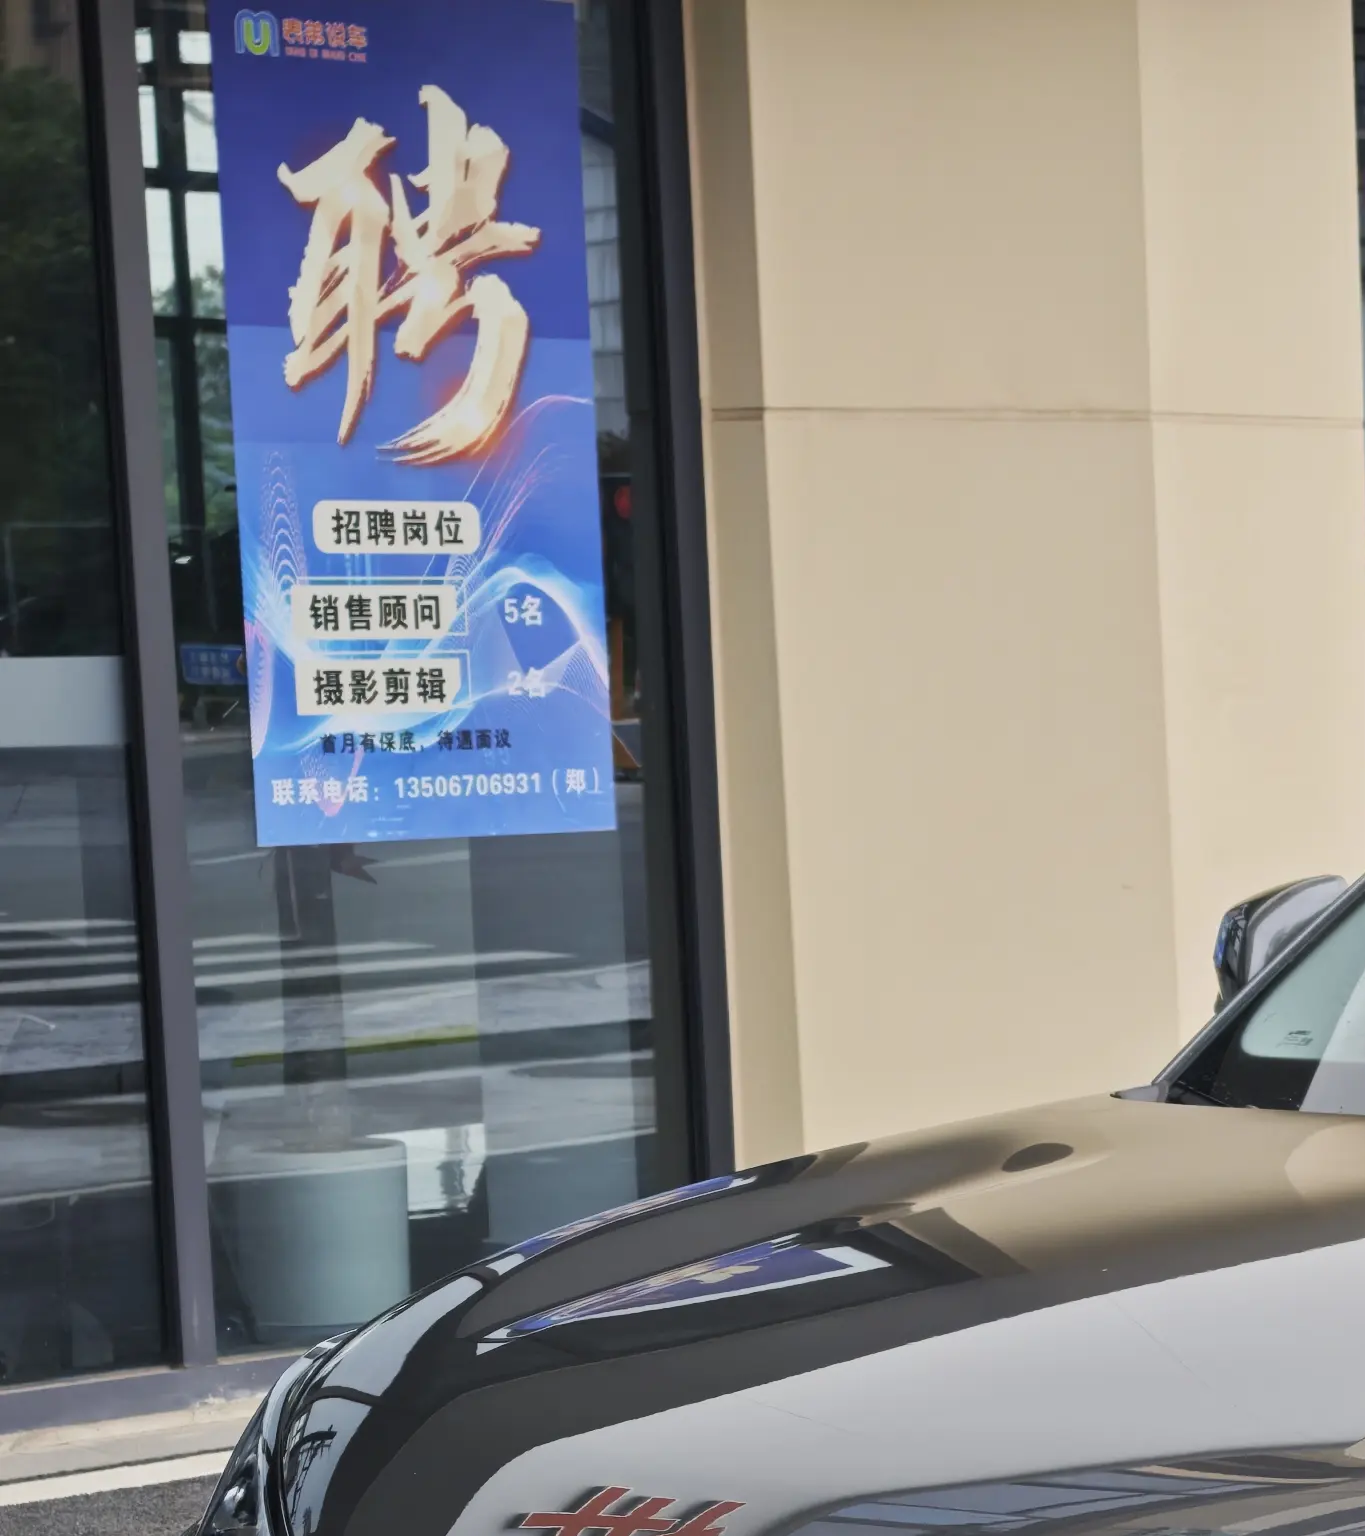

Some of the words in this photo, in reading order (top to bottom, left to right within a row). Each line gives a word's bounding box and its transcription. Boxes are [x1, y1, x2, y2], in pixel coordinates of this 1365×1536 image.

[277, 84, 542, 466] 聘
[332, 508, 464, 547] 招聘岗位
[309, 593, 441, 632] 销售顾问
[504, 597, 543, 627] 5名
[313, 667, 447, 706] 摄影剪辑
[508, 668, 546, 699] 2名
